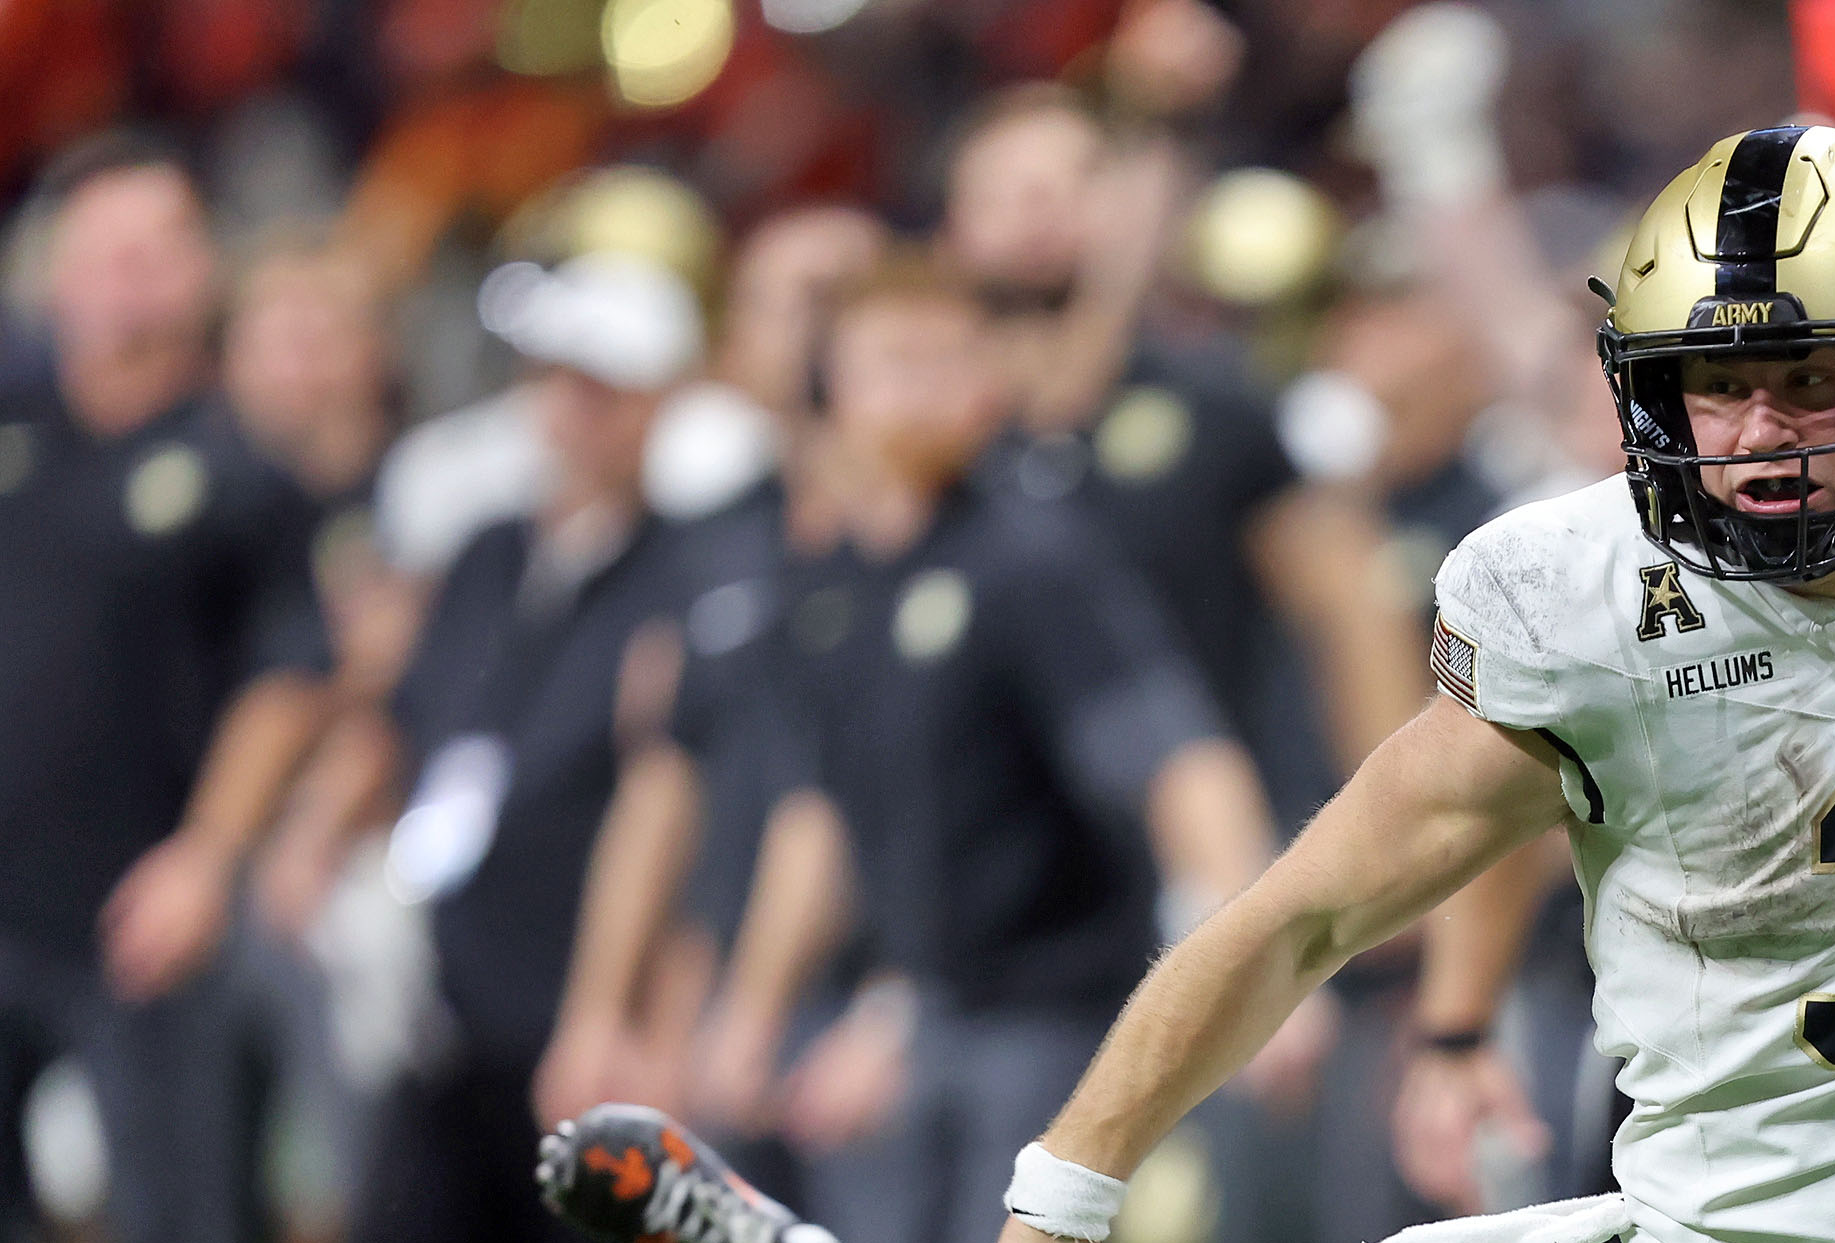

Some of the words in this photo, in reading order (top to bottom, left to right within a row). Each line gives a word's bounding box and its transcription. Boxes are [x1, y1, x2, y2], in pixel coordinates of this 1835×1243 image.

[1711, 301, 1774, 327] ARMY
[1630, 399, 1671, 449] NIGHTS
[1665, 650, 1774, 698] HELLUMS
